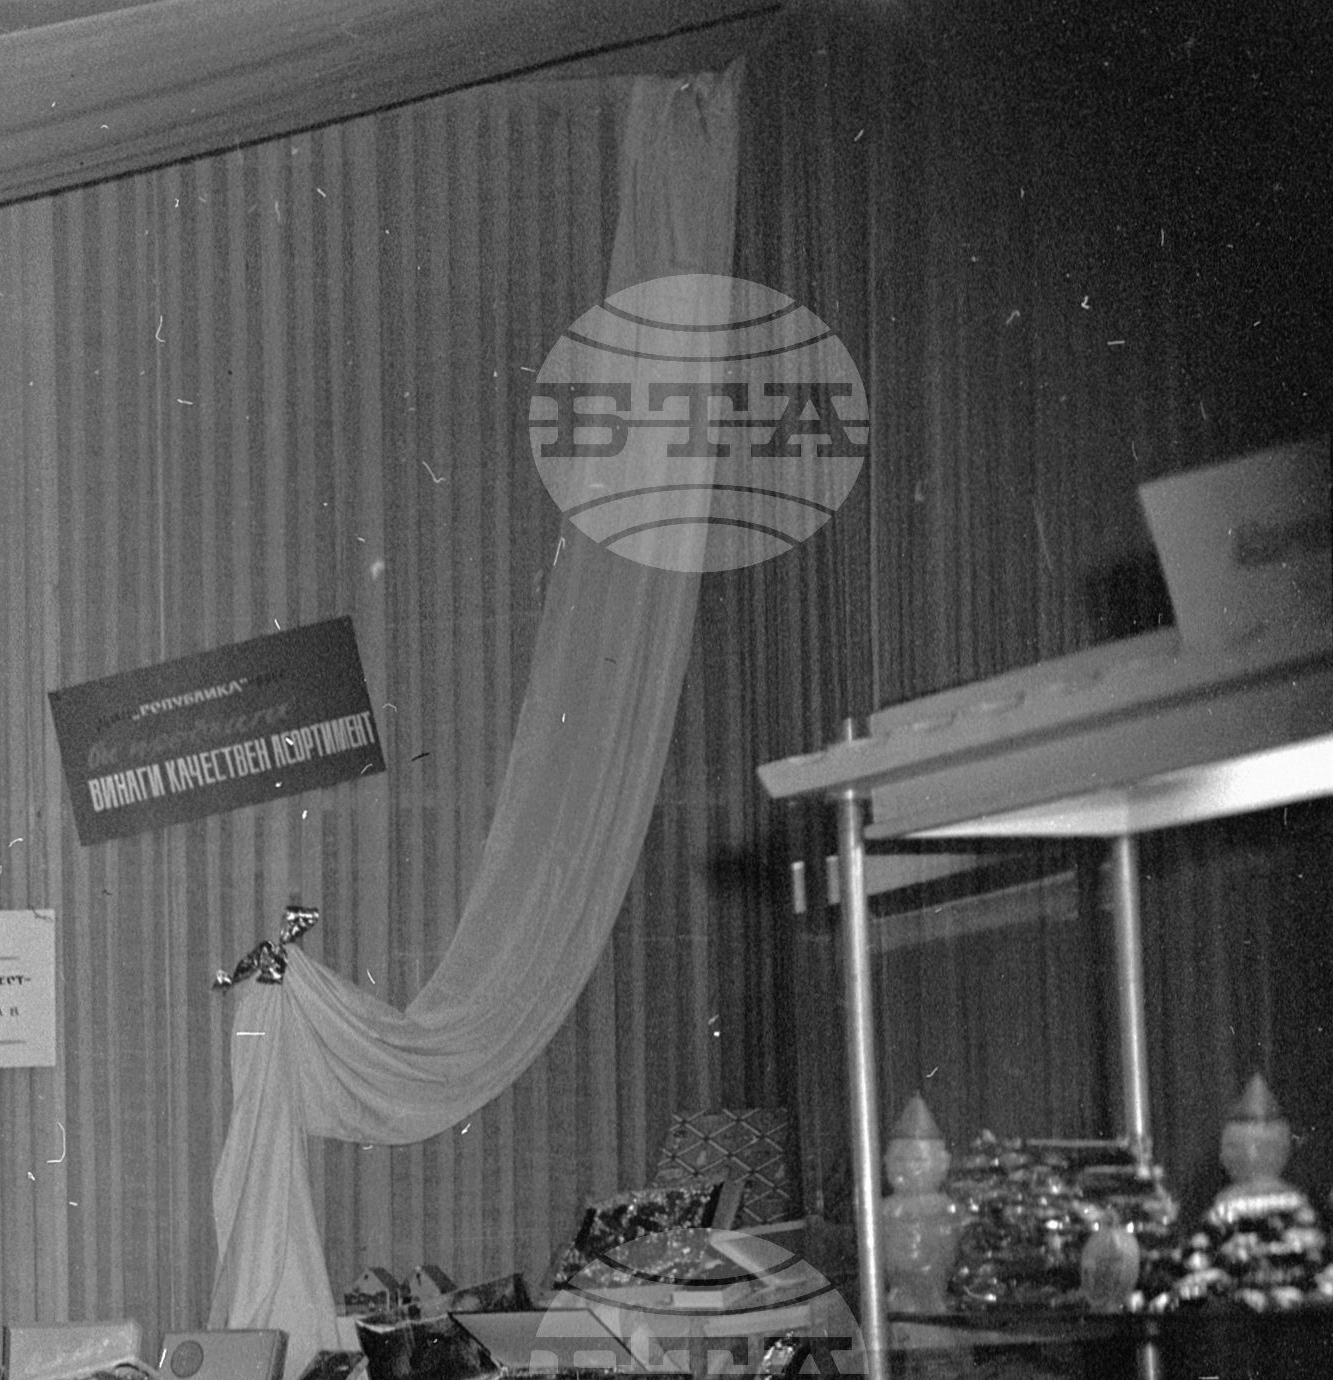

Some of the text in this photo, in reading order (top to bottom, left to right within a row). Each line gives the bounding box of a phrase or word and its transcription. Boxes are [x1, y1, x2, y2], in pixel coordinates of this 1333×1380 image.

[87, 762, 166, 812] ВИНАГИ
[163, 736, 274, 793] КАЧЕСТВЕН
[270, 710, 377, 768] АСОРТИМЕНТ
